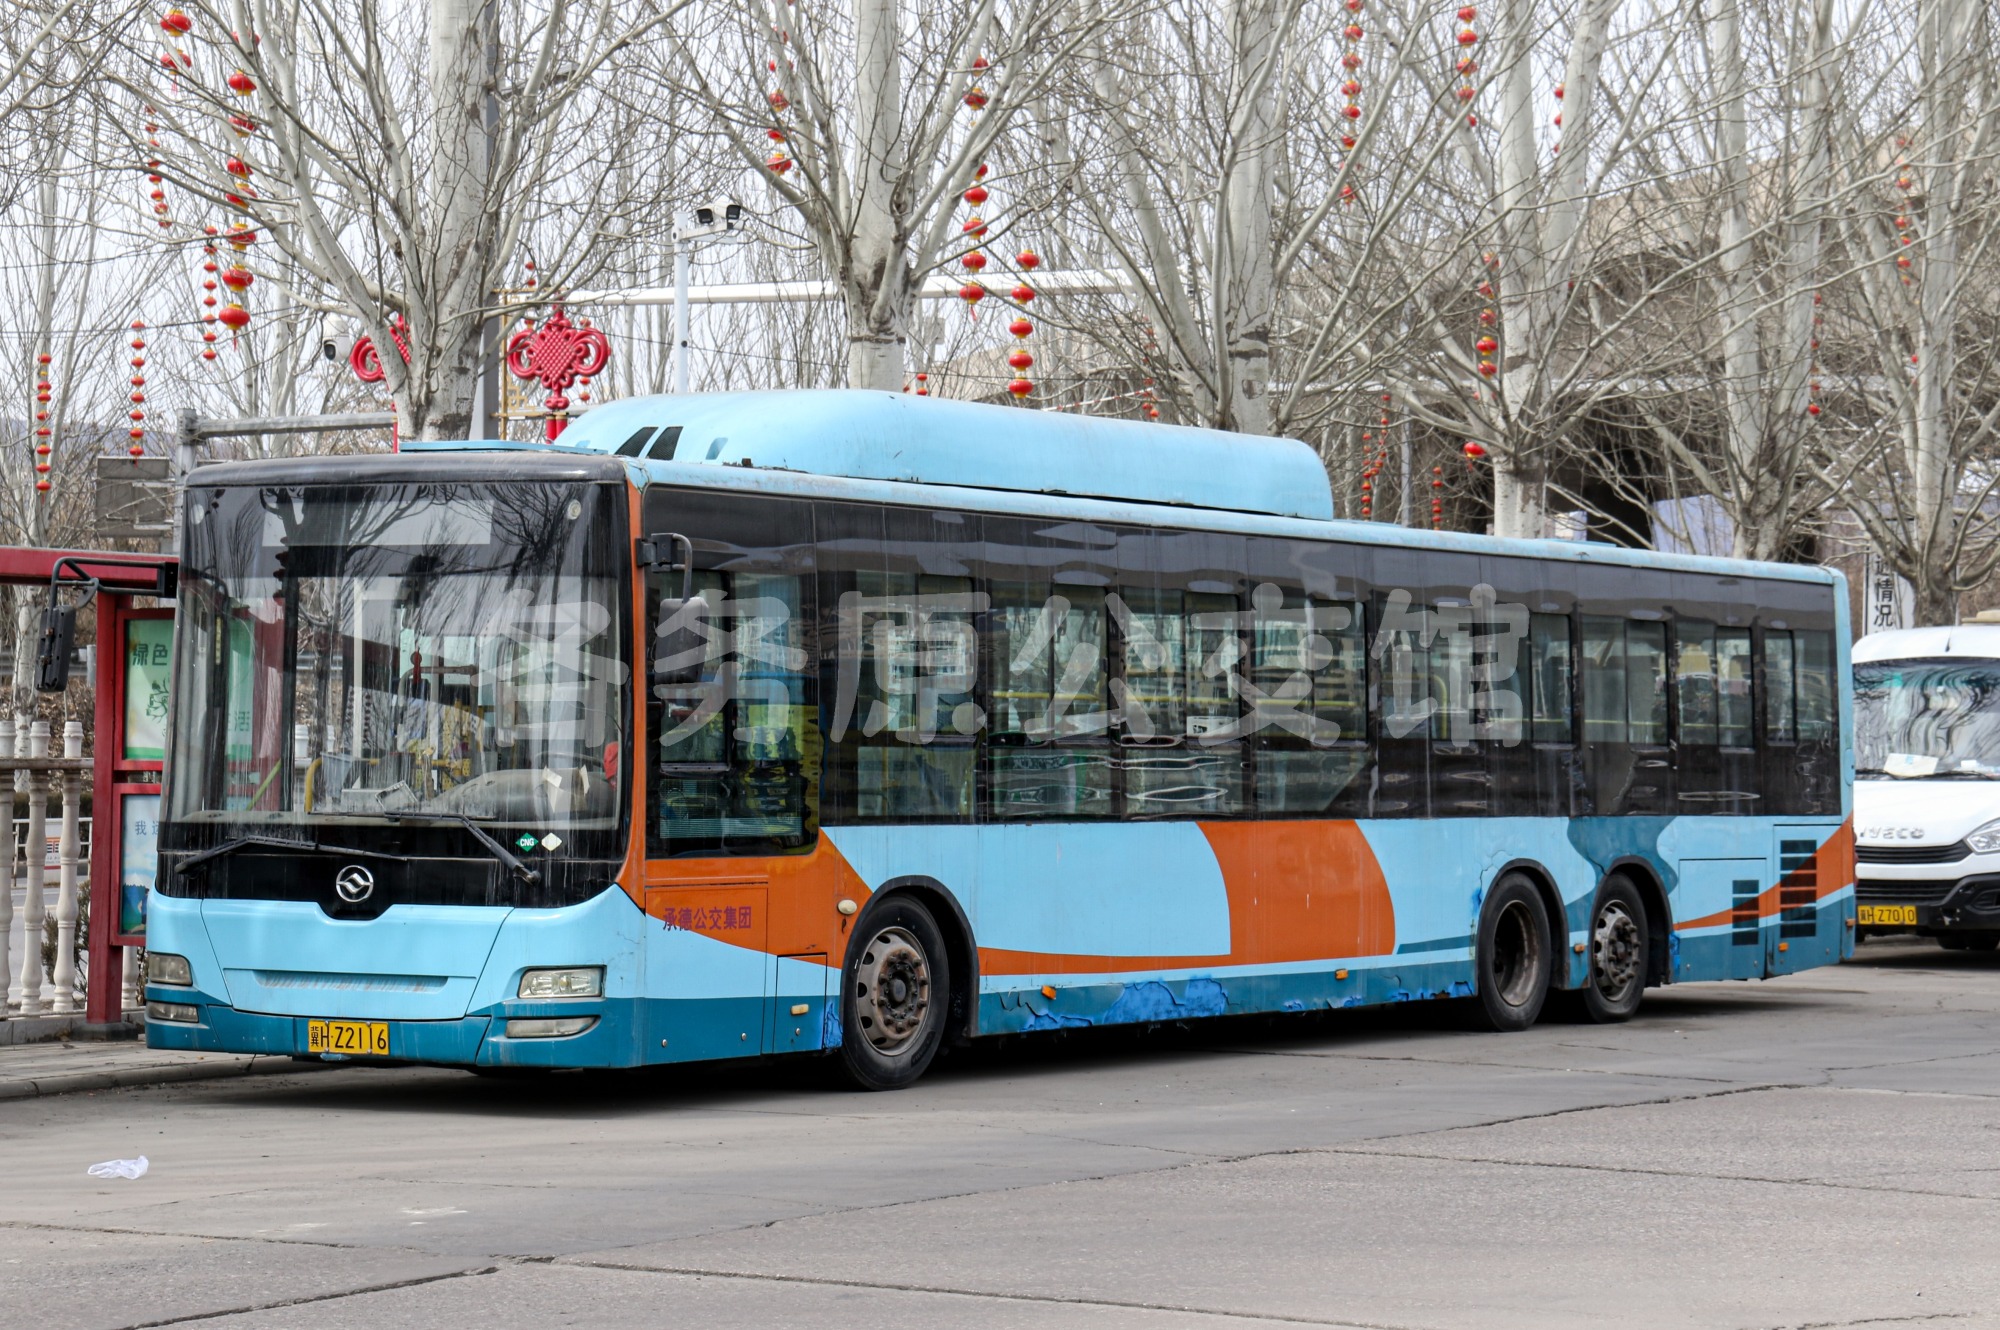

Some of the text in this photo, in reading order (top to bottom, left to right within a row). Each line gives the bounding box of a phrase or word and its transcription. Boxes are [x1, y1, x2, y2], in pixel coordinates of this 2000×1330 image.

[132, 643, 168, 666] 绿色
[520, 837, 535, 847] CNG
[1860, 827, 1925, 840] IVECO
[662, 905, 752, 931] 承德公交集团
